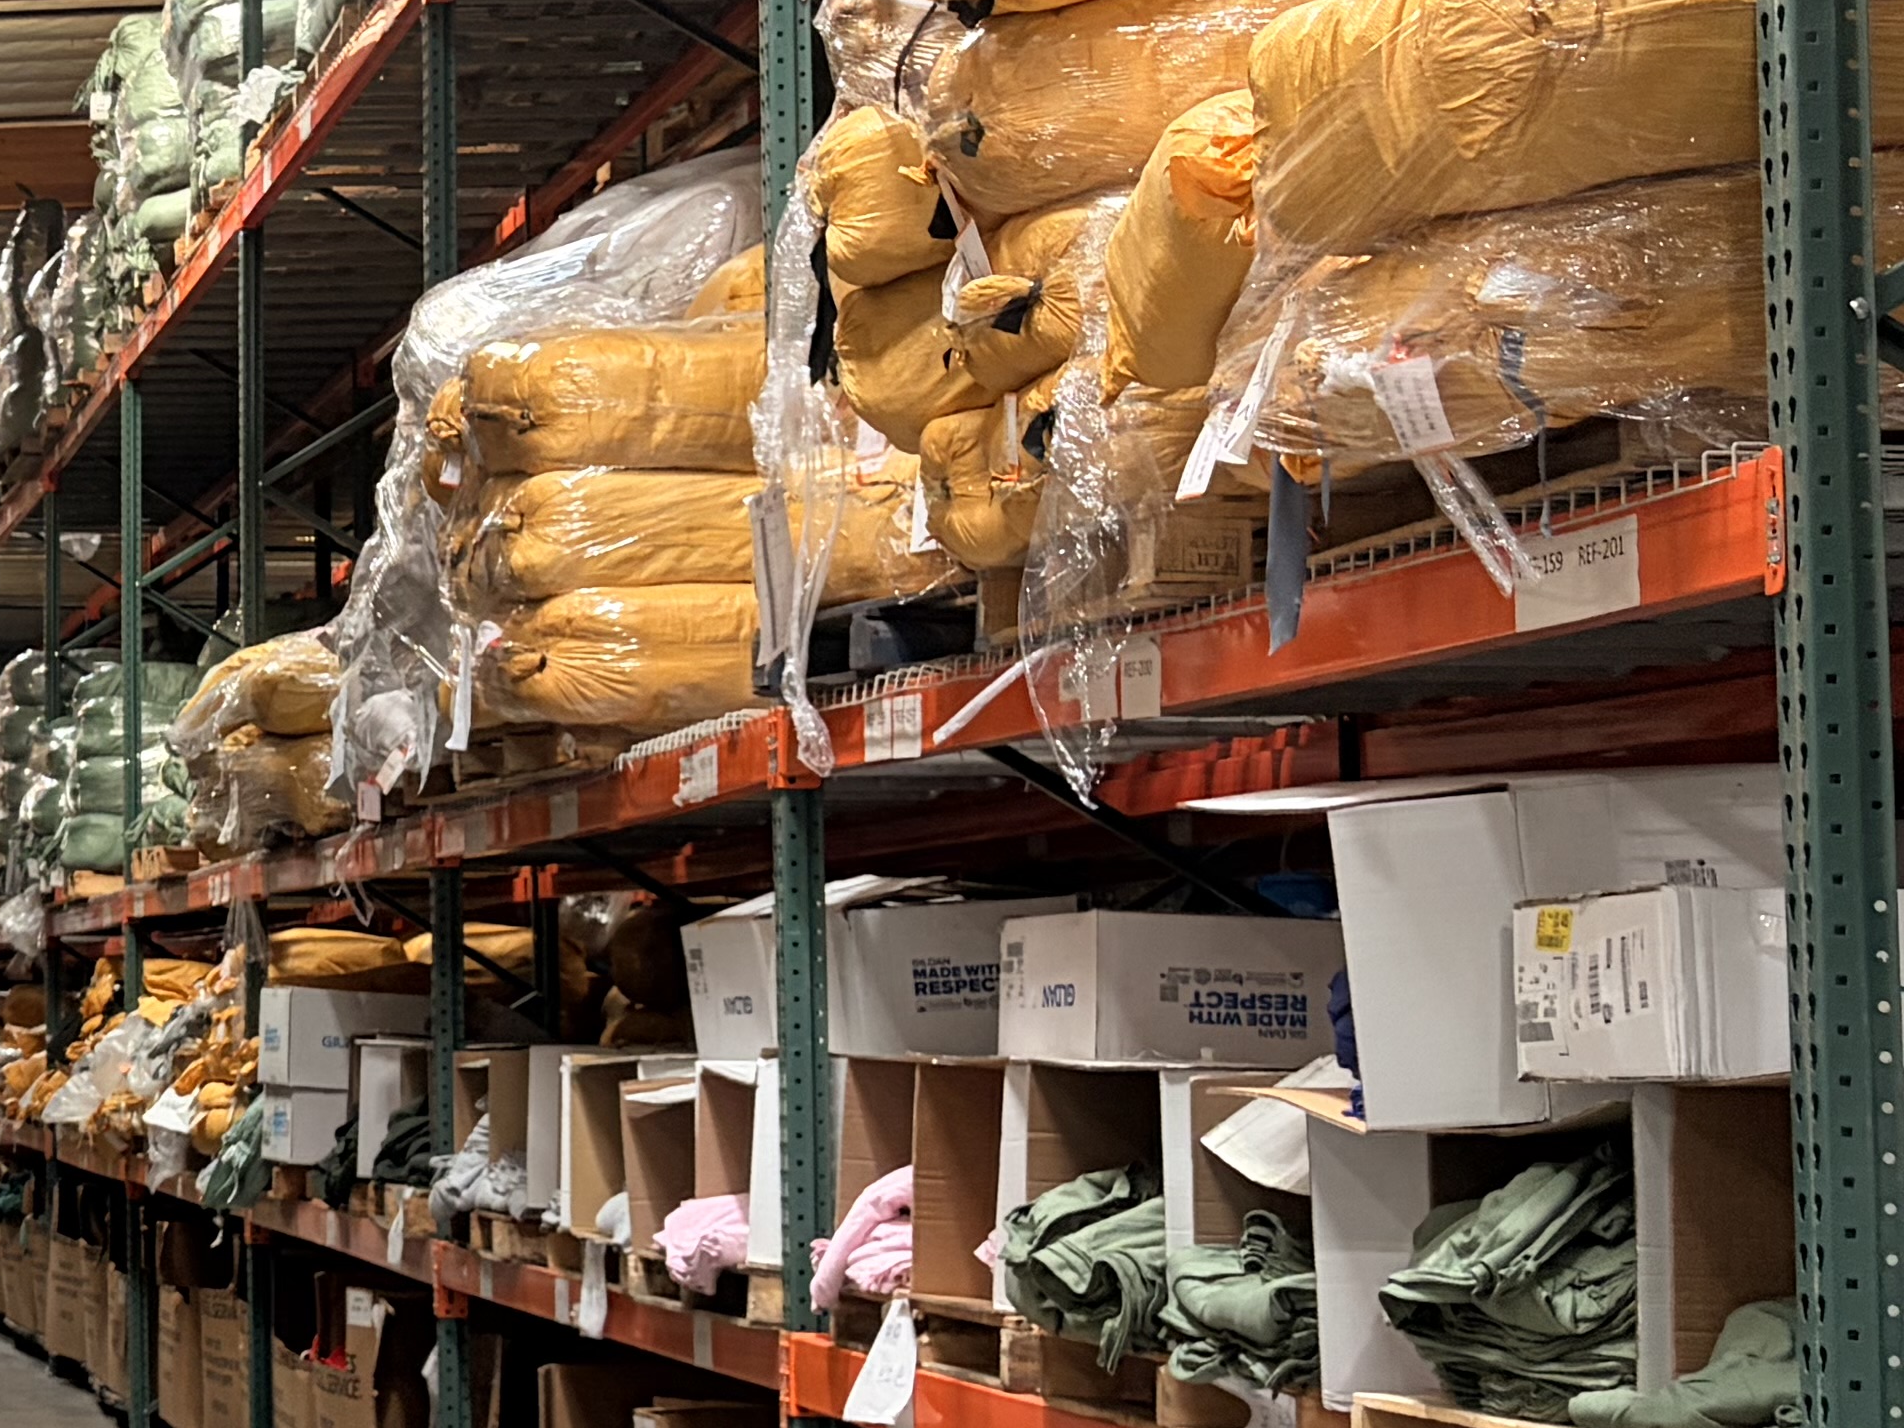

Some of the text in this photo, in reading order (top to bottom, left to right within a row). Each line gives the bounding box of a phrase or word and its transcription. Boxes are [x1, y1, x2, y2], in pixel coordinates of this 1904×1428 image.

[912, 965, 962, 980] MADE
[1189, 990, 1307, 1012] RESPECT
[1188, 1010, 1307, 1027] MADE WITH
